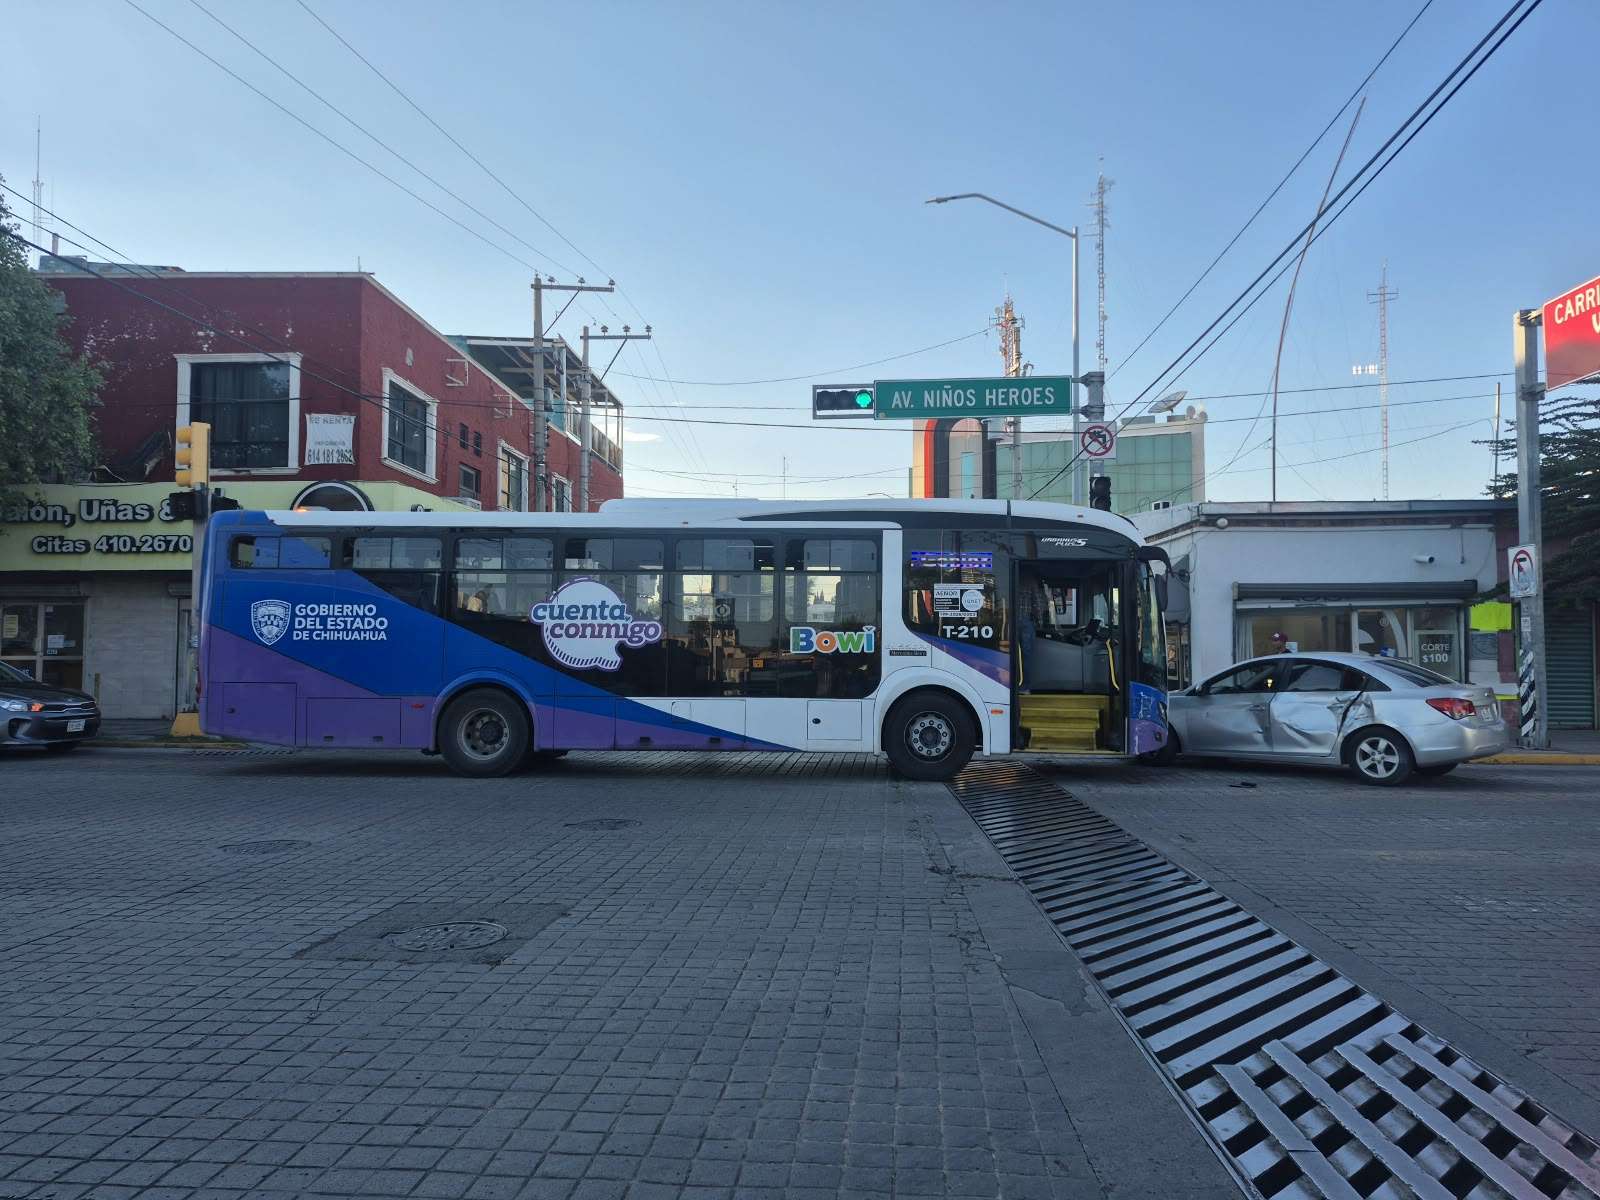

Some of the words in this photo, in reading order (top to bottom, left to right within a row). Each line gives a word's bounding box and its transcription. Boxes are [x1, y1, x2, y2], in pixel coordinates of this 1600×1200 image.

[892, 390, 914, 408] AV.
[924, 385, 976, 407] NIÑOS
[985, 388, 1055, 406] HEROES
[3, 502, 73, 526] alón,
[80, 499, 150, 521] Uñas
[33, 536, 86, 552] Citas
[295, 604, 377, 616] GOBIERNO
[294, 617, 323, 629] DEL
[327, 617, 388, 629] ESTADO
[293, 631, 310, 640] DE
[312, 631, 387, 640] CHIHUAHUA
[550, 622, 659, 644] conmigo
[943, 625, 993, 639] T-210
[1421, 643, 1449, 651] CORTE
[1423, 653, 1448, 663] $100
